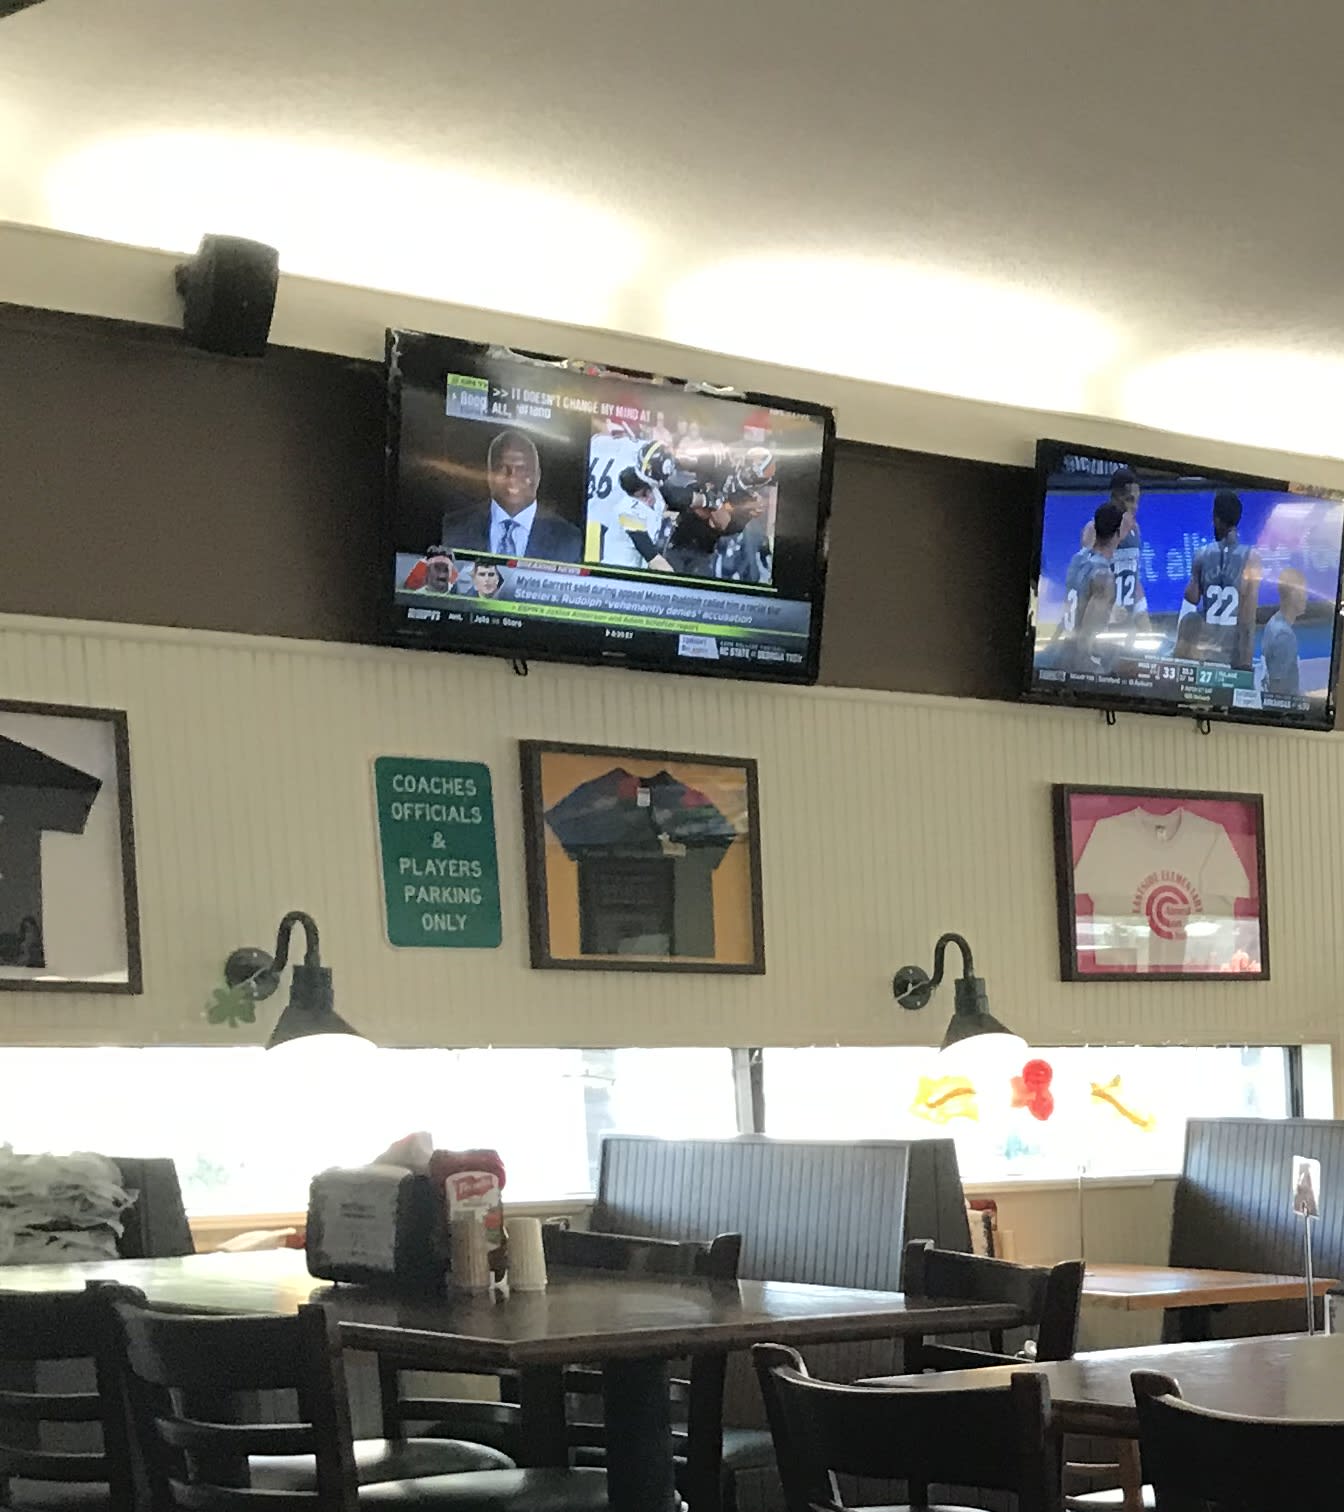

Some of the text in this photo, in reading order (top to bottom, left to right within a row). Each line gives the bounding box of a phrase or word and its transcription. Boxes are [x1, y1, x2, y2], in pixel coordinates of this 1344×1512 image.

[563, 396, 599, 415] CHANGE
[601, 403, 615, 416] MY
[615, 404, 639, 421] MIND
[640, 410, 651, 422] AT
[1115, 574, 1136, 606] 12
[561, 594, 602, 609] Rudolph
[702, 611, 753, 625] accusation
[1206, 585, 1239, 626] 22
[1162, 666, 1213, 683] 33 27
[392, 773, 477, 797] COACHES
[391, 801, 483, 825] OFFICIALS
[431, 831, 447, 850] &
[399, 857, 483, 878] PLAYERS
[404, 884, 483, 905] PARKING
[421, 912, 468, 932] ONLY
